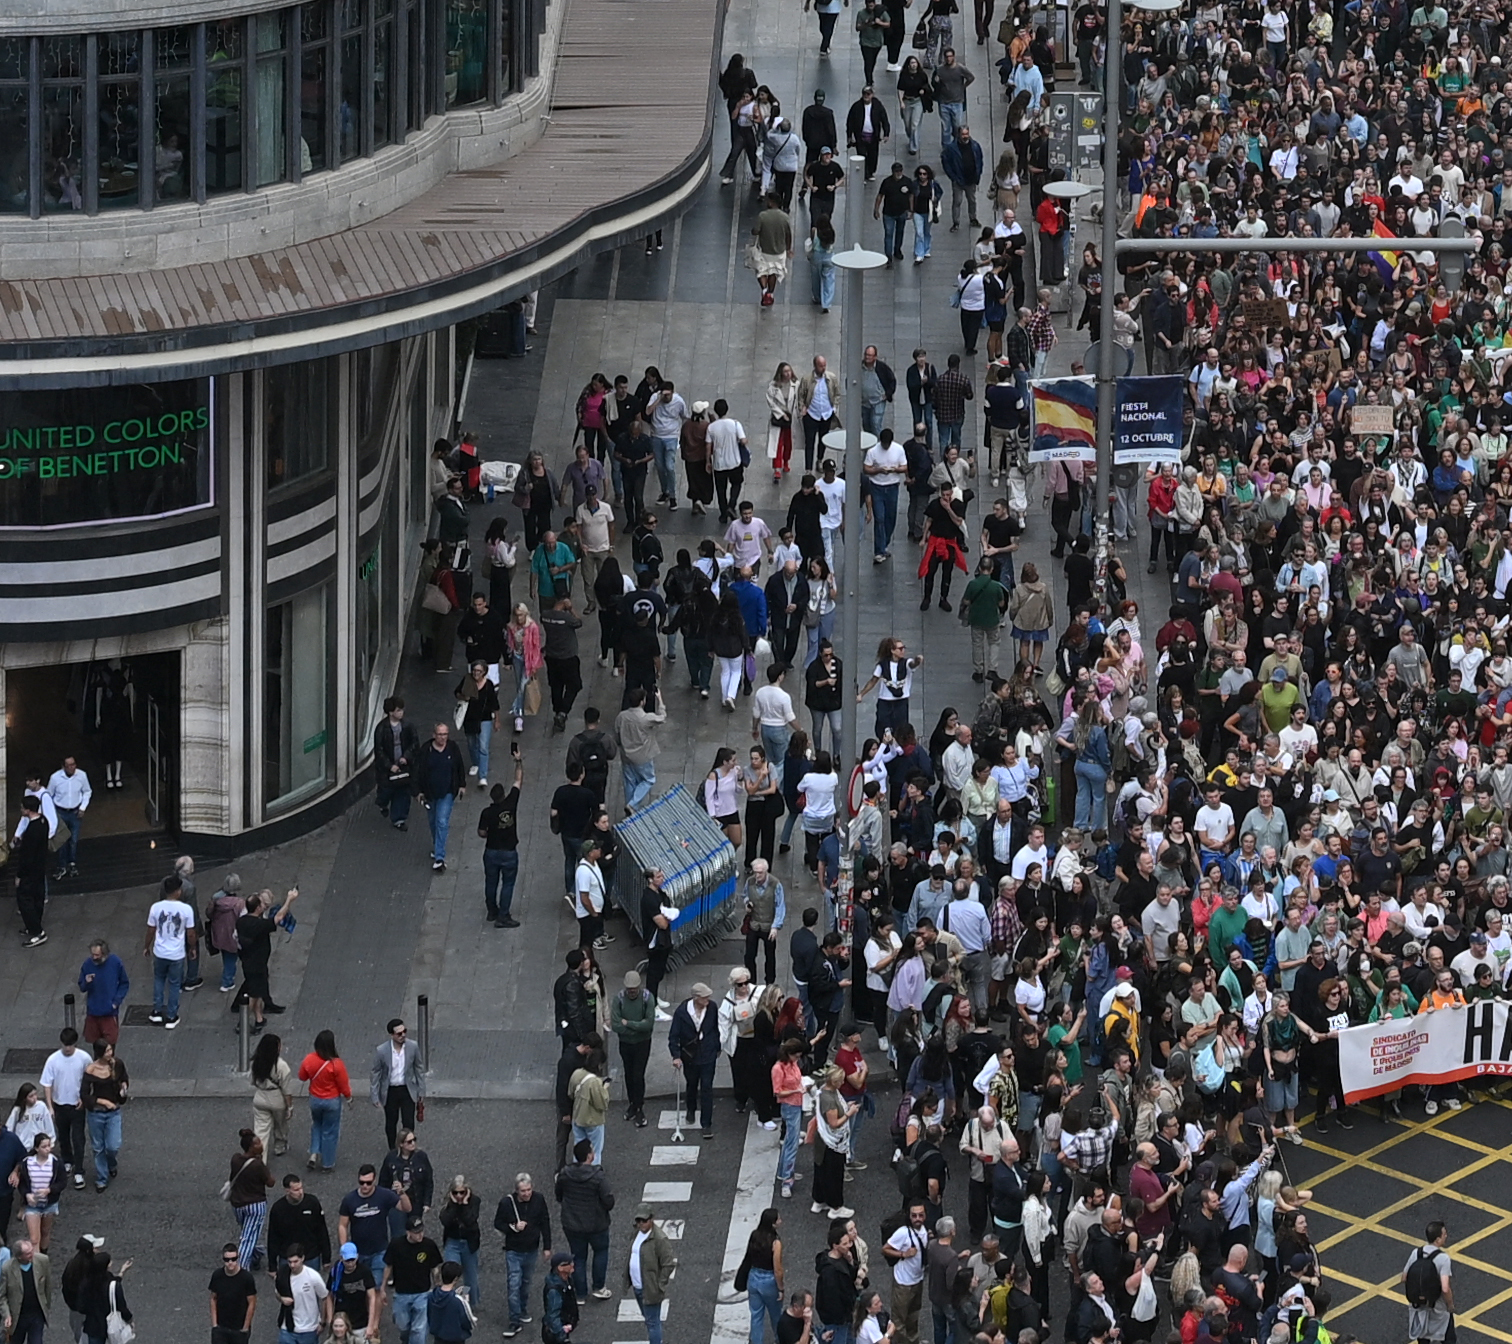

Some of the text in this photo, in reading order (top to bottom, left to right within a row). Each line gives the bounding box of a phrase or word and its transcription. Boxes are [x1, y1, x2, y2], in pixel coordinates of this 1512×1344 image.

[1120, 412, 1167, 422] NACIONAL
[103, 407, 209, 443] COLORS
[1120, 433, 1174, 444] 12 OCTUBRE
[1372, 1029, 1417, 1046] SINDICATO
[1373, 1045, 1384, 1057] DE
[1373, 1065, 1384, 1075] DE
